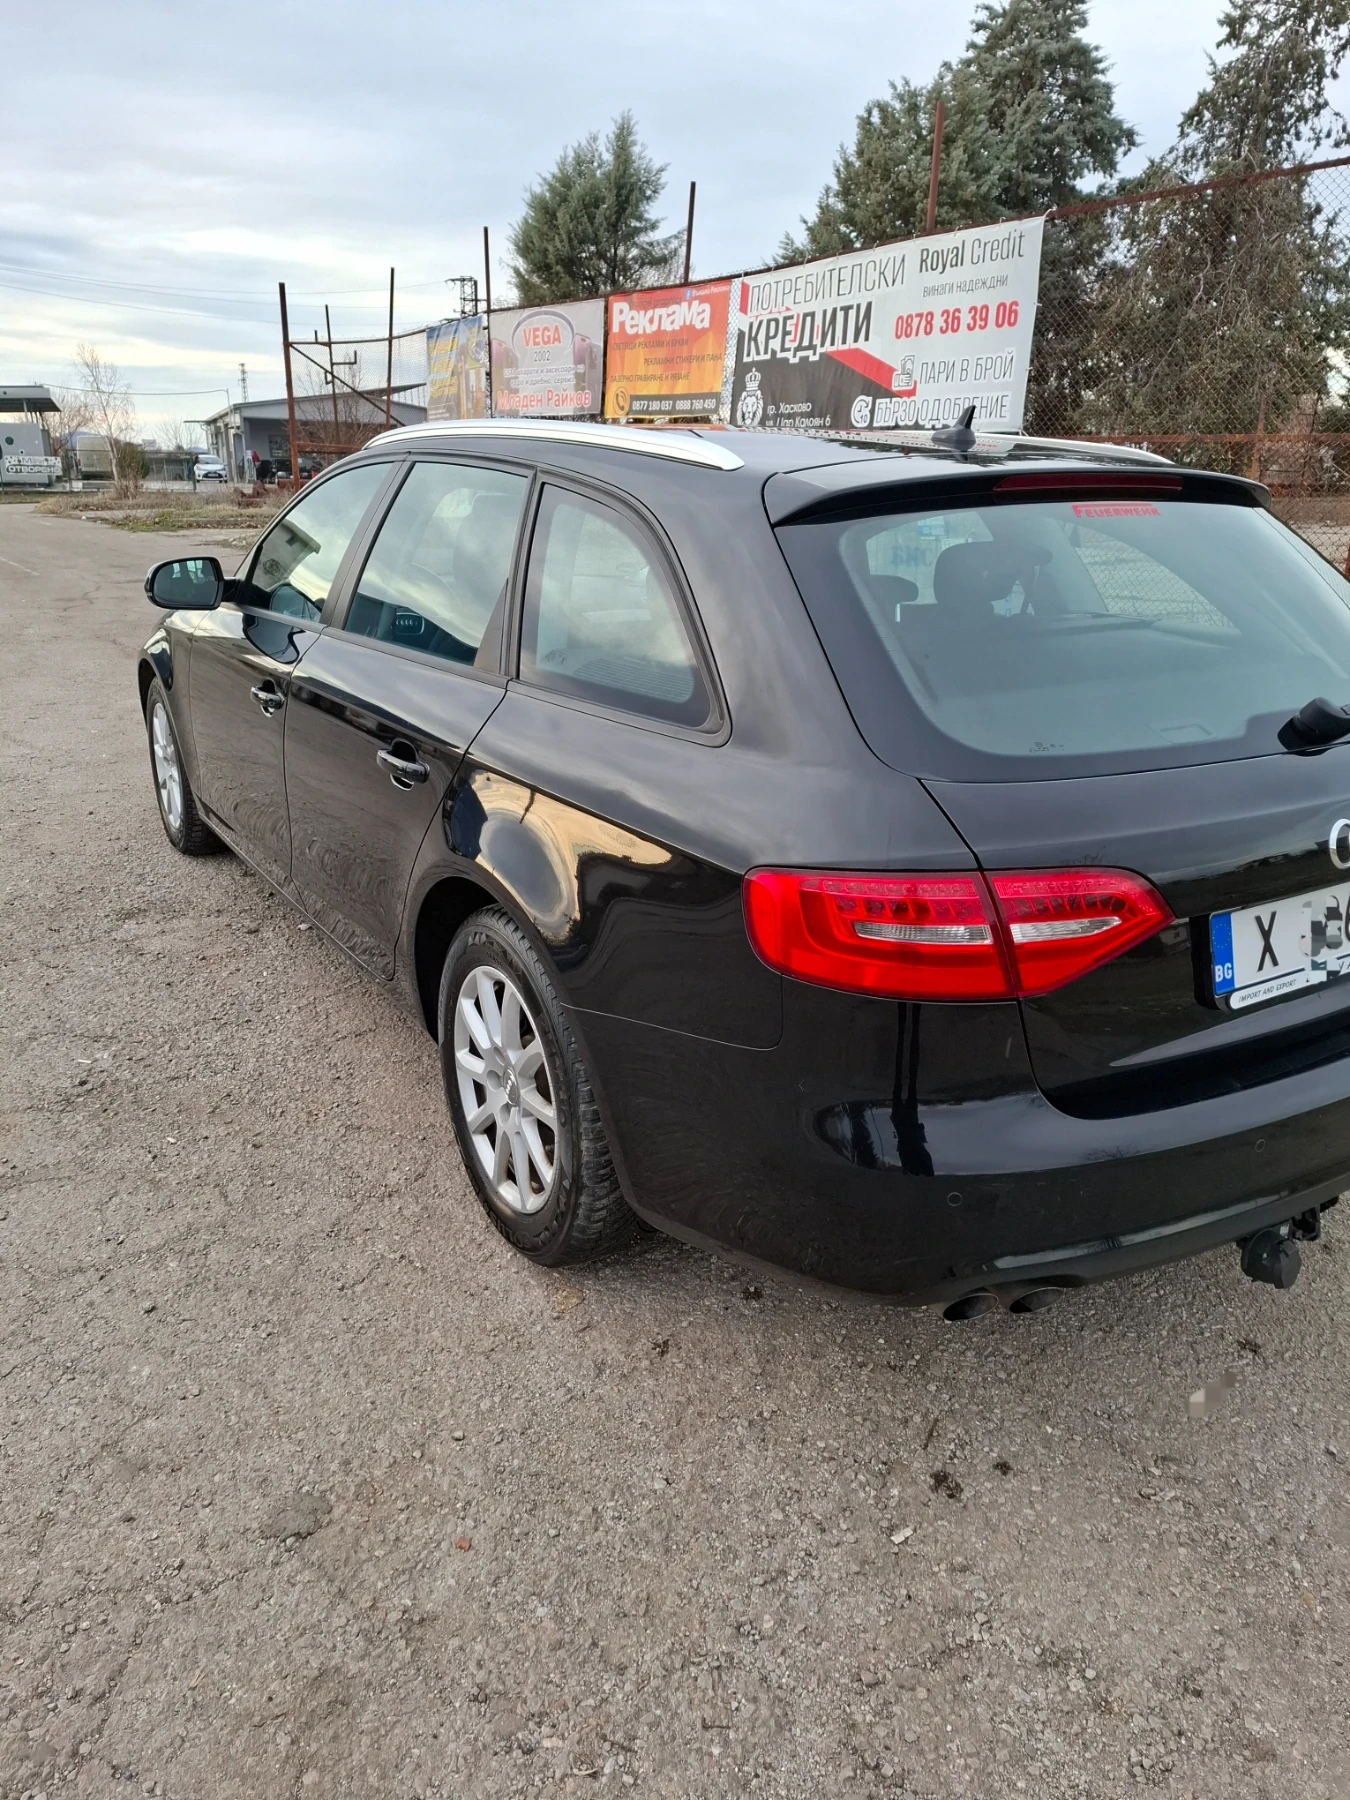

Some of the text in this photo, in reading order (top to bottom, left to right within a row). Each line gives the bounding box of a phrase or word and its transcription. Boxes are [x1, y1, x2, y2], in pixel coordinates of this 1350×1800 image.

[919, 229, 1025, 274] Royal Credit
[750, 254, 906, 312] ПОТРЕБИТЕЛСКИ
[922, 274, 1008, 298] винаги надеждни
[746, 301, 872, 359] КРЕДИТИ
[895, 300, 1019, 340] 0878 36 39 06
[523, 325, 562, 347] VEGA
[534, 350, 550, 362] 2002
[920, 350, 1014, 384] ПАРИ В БРОЙ
[497, 388, 591, 411] Младен Райков
[632, 401, 647, 411] 0877
[676, 400, 690, 410] 0888
[704, 399, 716, 409] 450
[779, 402, 812, 414] Хасково
[795, 416, 824, 428] Калоян
[825, 414, 830, 426] 6
[876, 400, 917, 424] БЪРЗО
[1072, 503, 1161, 518] FEUERWEHR
[1214, 962, 1232, 982] BG
[1239, 979, 1296, 1003] IMPORT AND EXPORT
